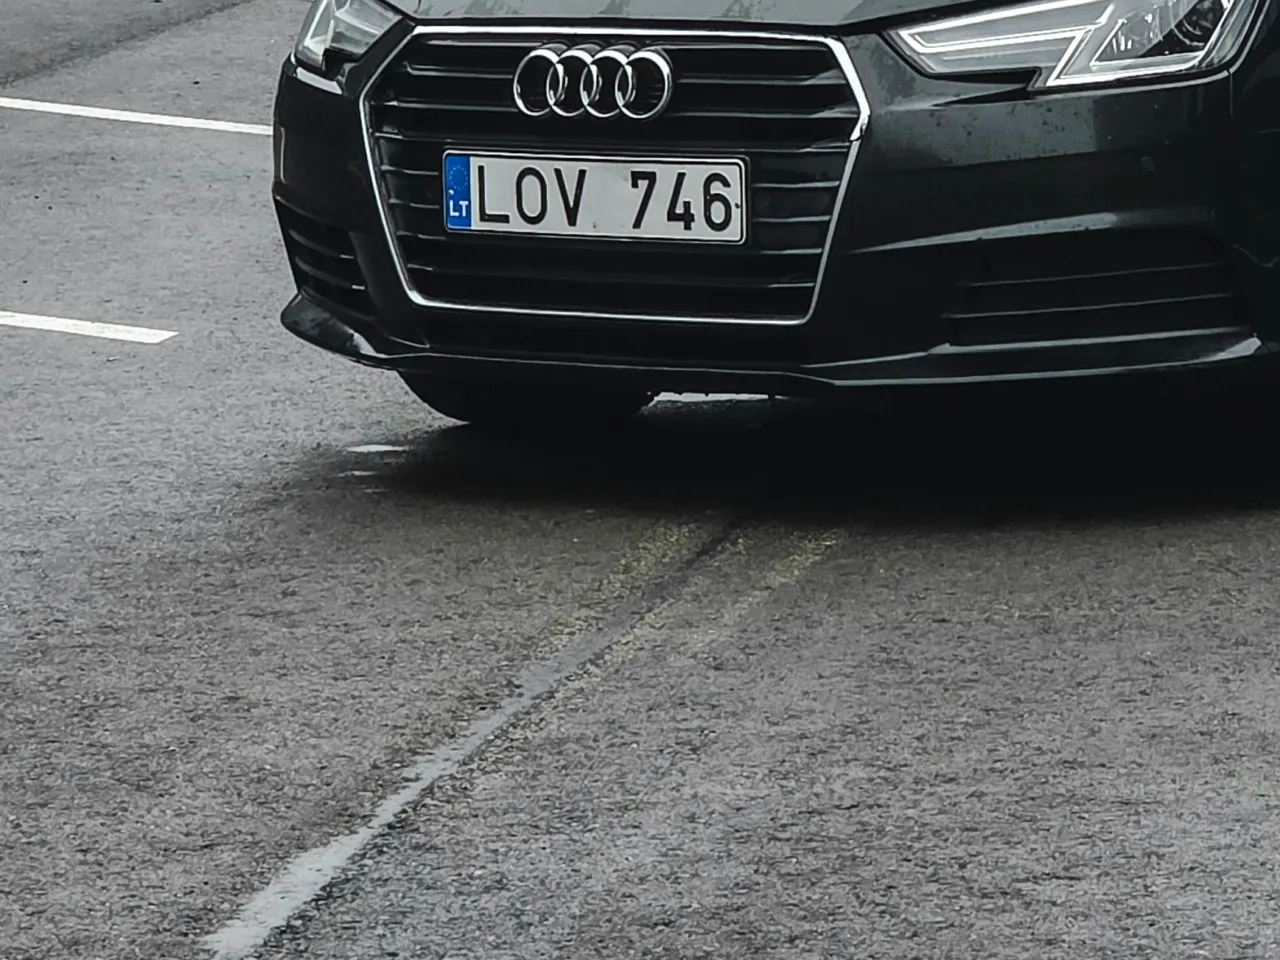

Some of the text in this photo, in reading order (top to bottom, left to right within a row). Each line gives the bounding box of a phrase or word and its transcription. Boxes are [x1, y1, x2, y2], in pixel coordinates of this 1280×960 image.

[449, 200, 469, 218] LT
[477, 165, 732, 232] LOV 746
